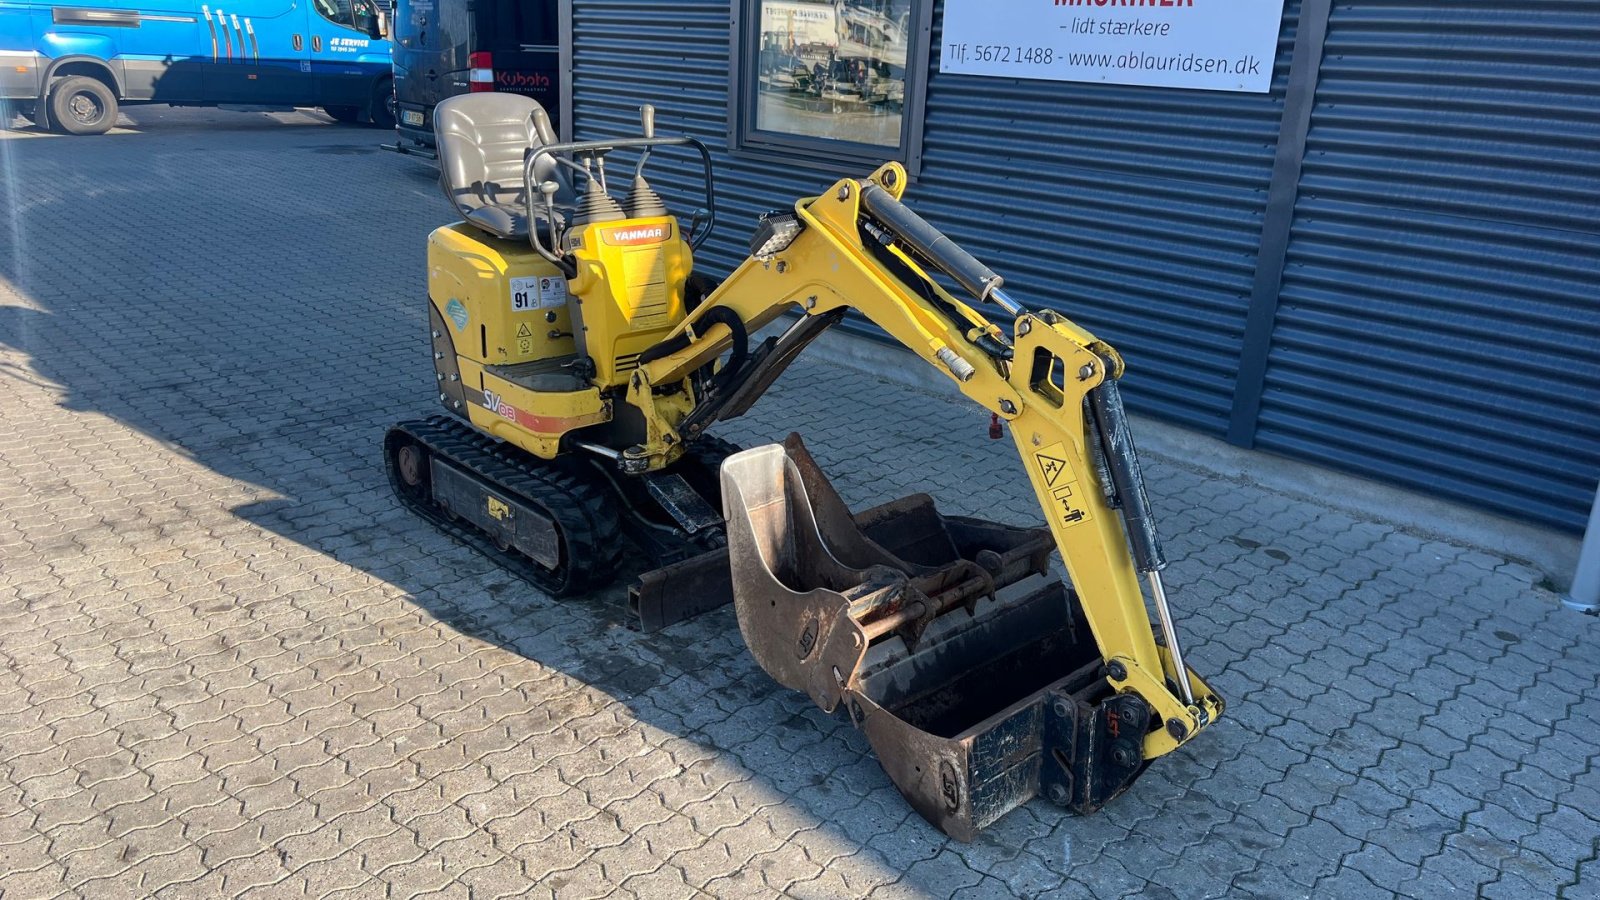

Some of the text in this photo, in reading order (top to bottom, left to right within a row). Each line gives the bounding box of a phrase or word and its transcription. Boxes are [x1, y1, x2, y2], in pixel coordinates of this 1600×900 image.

[1071, 16, 1096, 34] lidt
[1098, 18, 1170, 36] stærkere
[330, 37, 369, 47] JE SERVICE
[949, 44, 969, 64] Tlf.
[975, 45, 1011, 63] 5672
[1014, 47, 1054, 64] 1488
[1068, 51, 1261, 75] www.ablauridsen.dk
[496, 71, 550, 87] Kubota
[614, 228, 662, 240] YANMAR
[514, 291, 528, 308] 91
